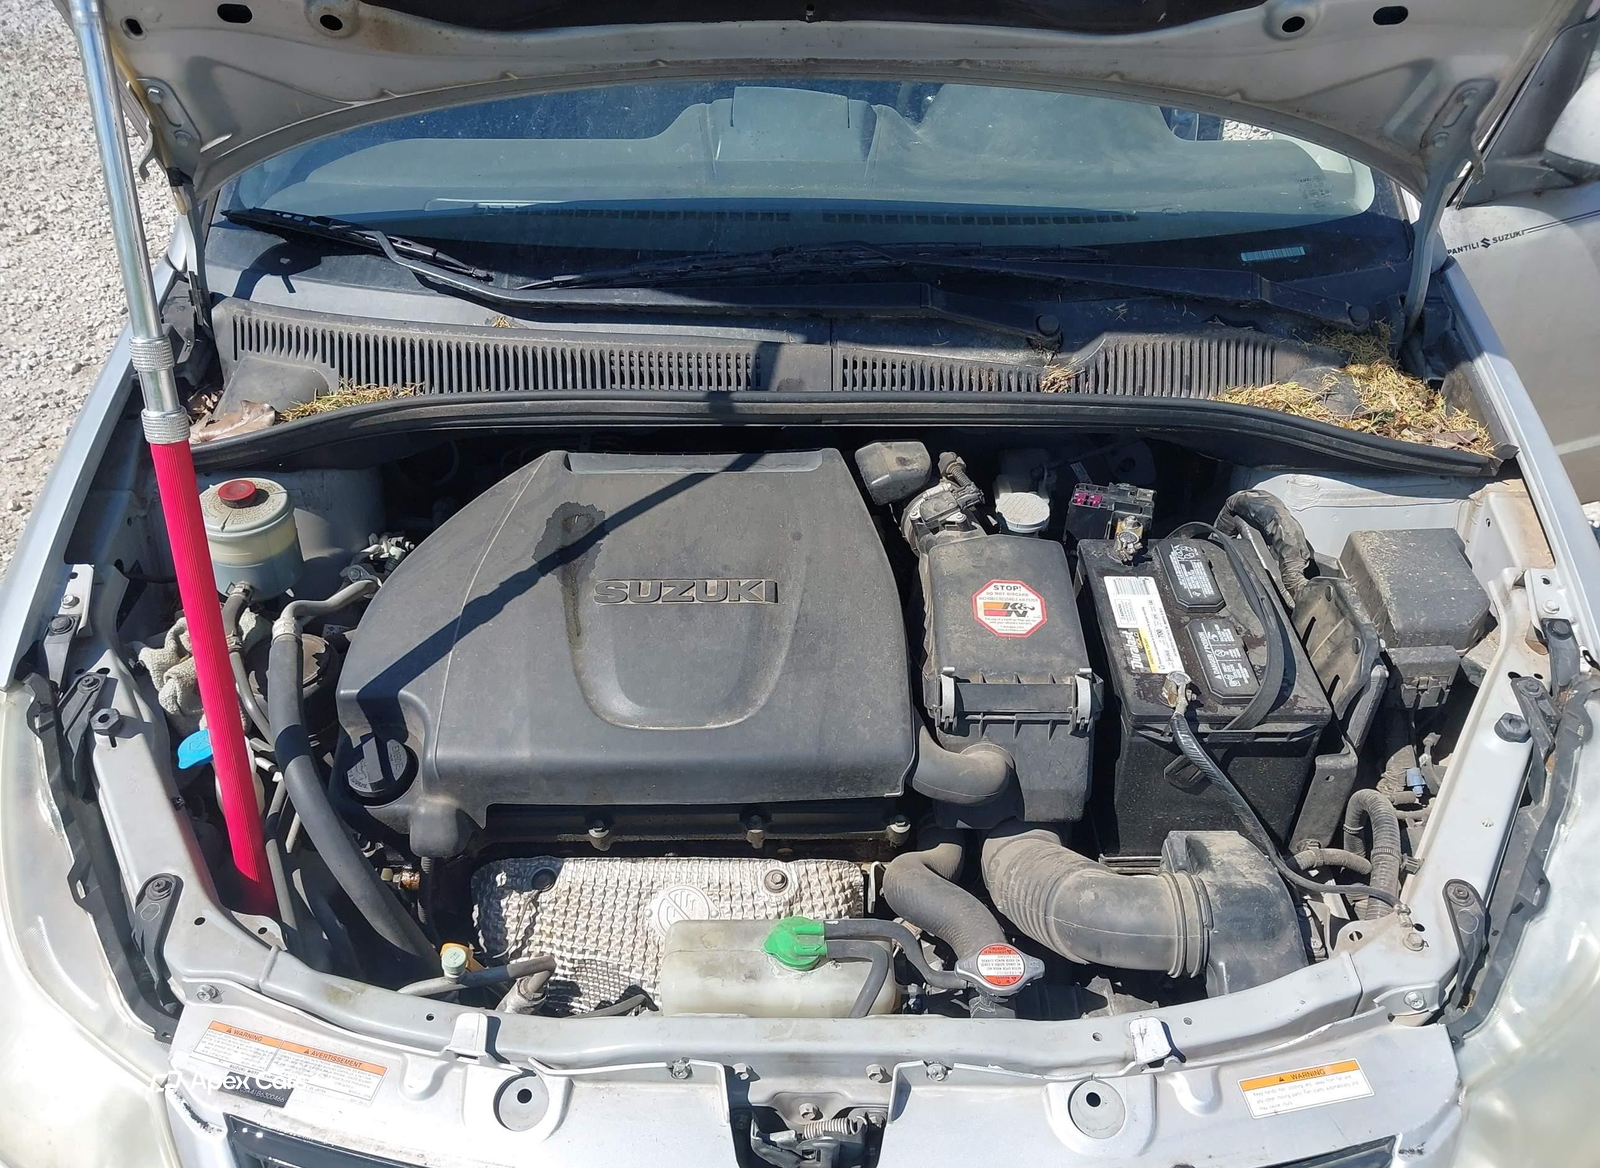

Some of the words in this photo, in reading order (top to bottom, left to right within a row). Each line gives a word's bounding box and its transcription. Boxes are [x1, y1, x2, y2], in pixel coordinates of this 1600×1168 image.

[1447, 242, 1479, 255] PANTILI
[1492, 230, 1525, 243] SUZUKI
[594, 580, 779, 604] SUZUKI
[1133, 631, 1143, 649] GOLD
[1119, 629, 1144, 670] Duralast
[233, 1029, 262, 1041] WARNING
[310, 1050, 362, 1068] AVERTISSEMENT
[1290, 1069, 1326, 1080] WARNING
